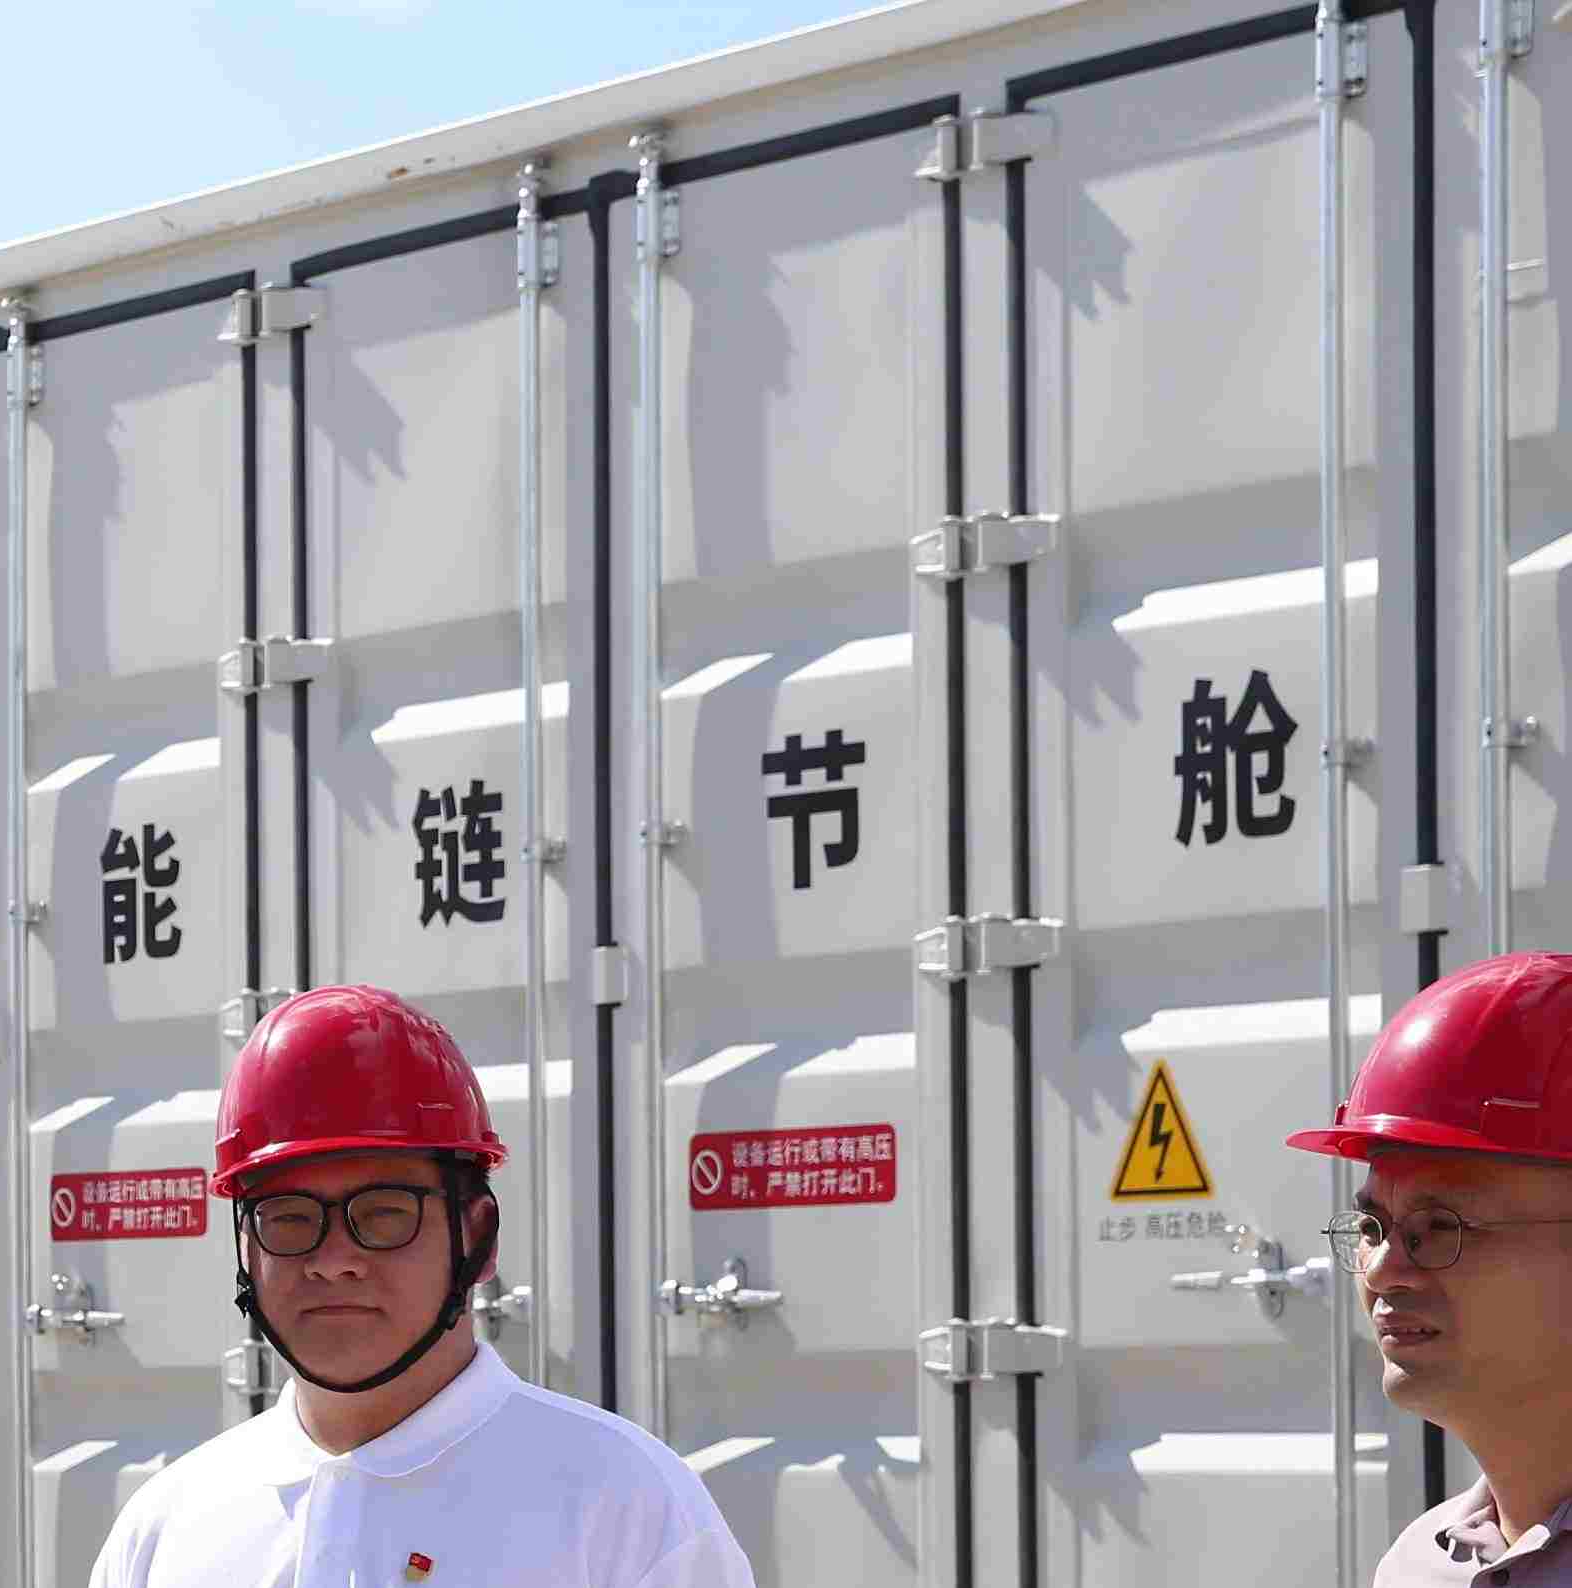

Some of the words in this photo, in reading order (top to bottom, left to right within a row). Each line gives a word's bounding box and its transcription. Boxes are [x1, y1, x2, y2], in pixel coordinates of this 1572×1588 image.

[99, 822, 184, 966] 能
[410, 779, 508, 930] 链
[760, 729, 866, 890] 节
[1173, 668, 1298, 849] 舱
